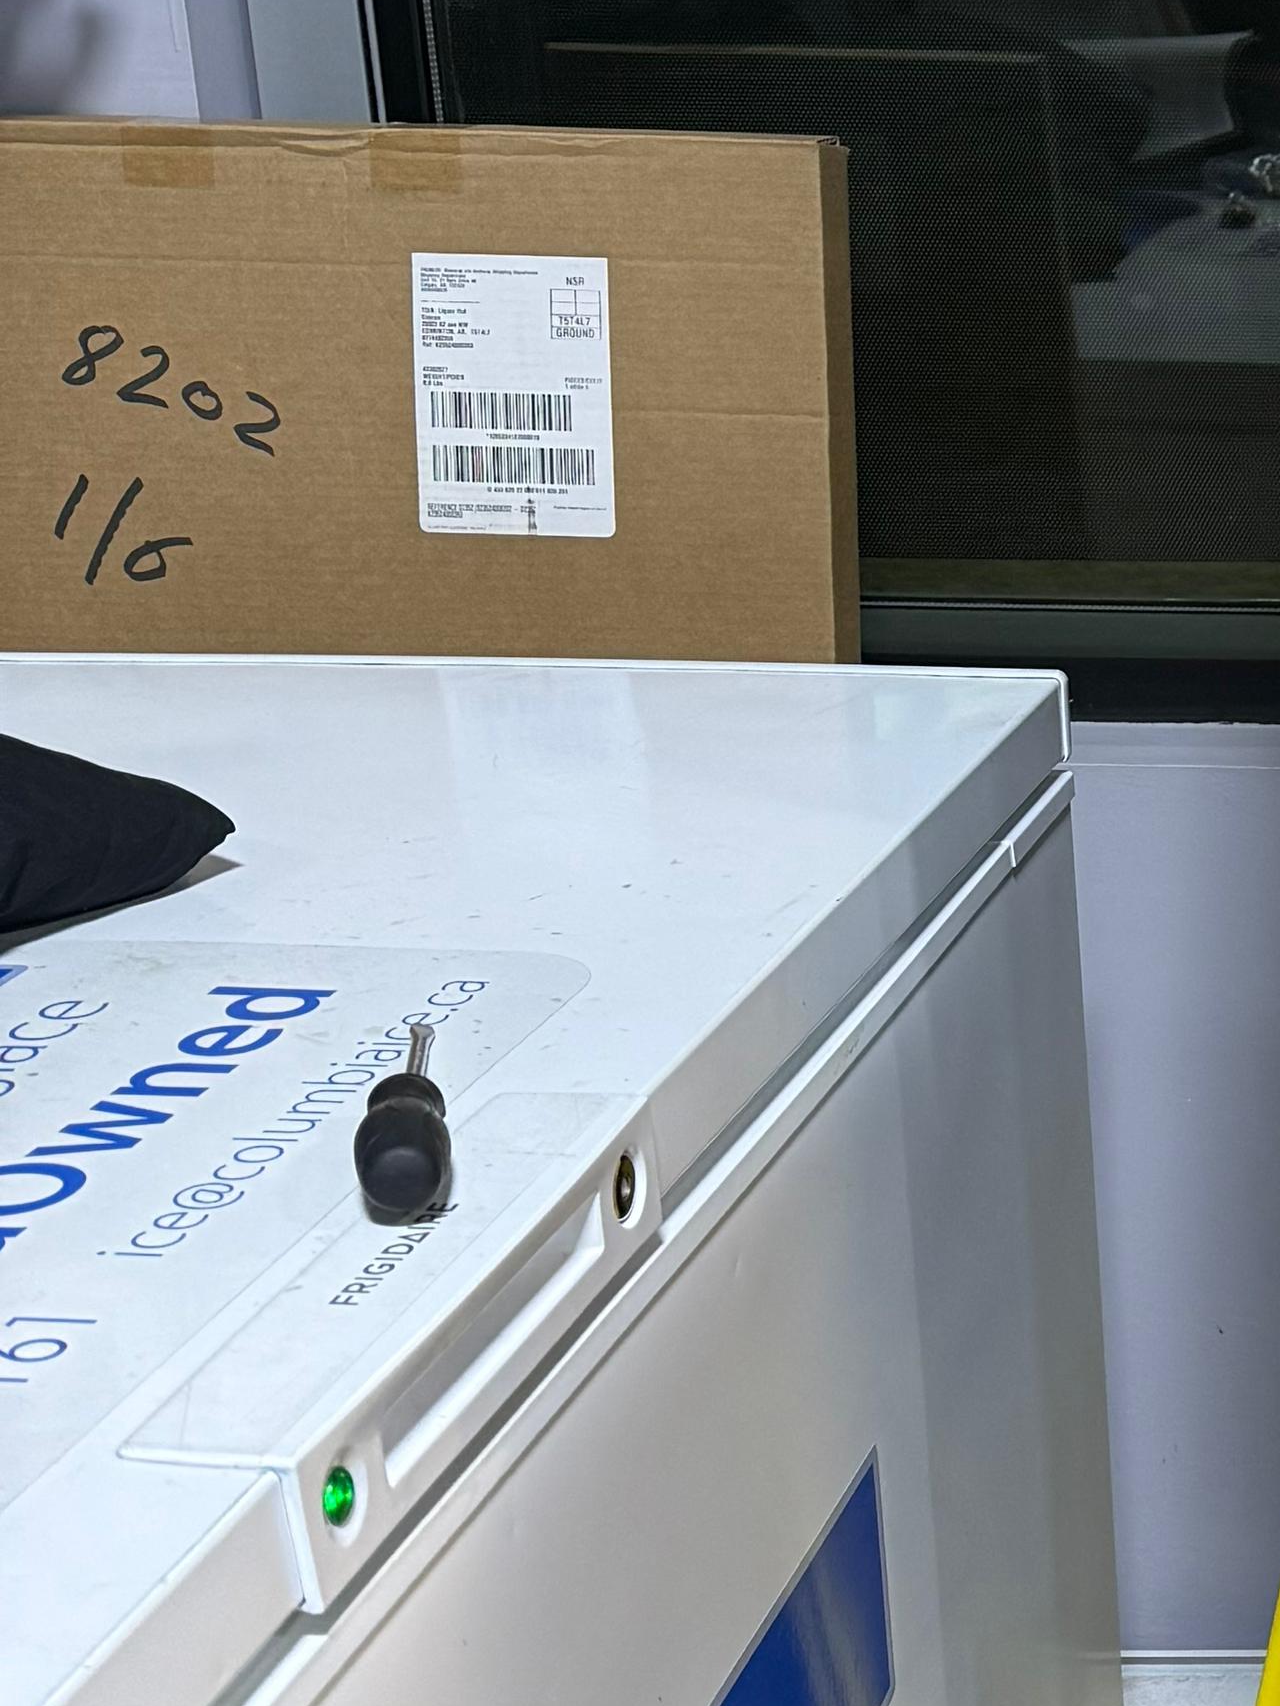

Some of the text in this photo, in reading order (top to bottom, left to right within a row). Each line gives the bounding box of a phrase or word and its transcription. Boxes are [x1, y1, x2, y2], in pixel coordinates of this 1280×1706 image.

[62, 325, 281, 457] 8202
[556, 327, 595, 339] GROUND
[97, 980, 490, 1257] ice@columbiaice.ca
[329, 1201, 460, 1306] FRIGIDAIRE
